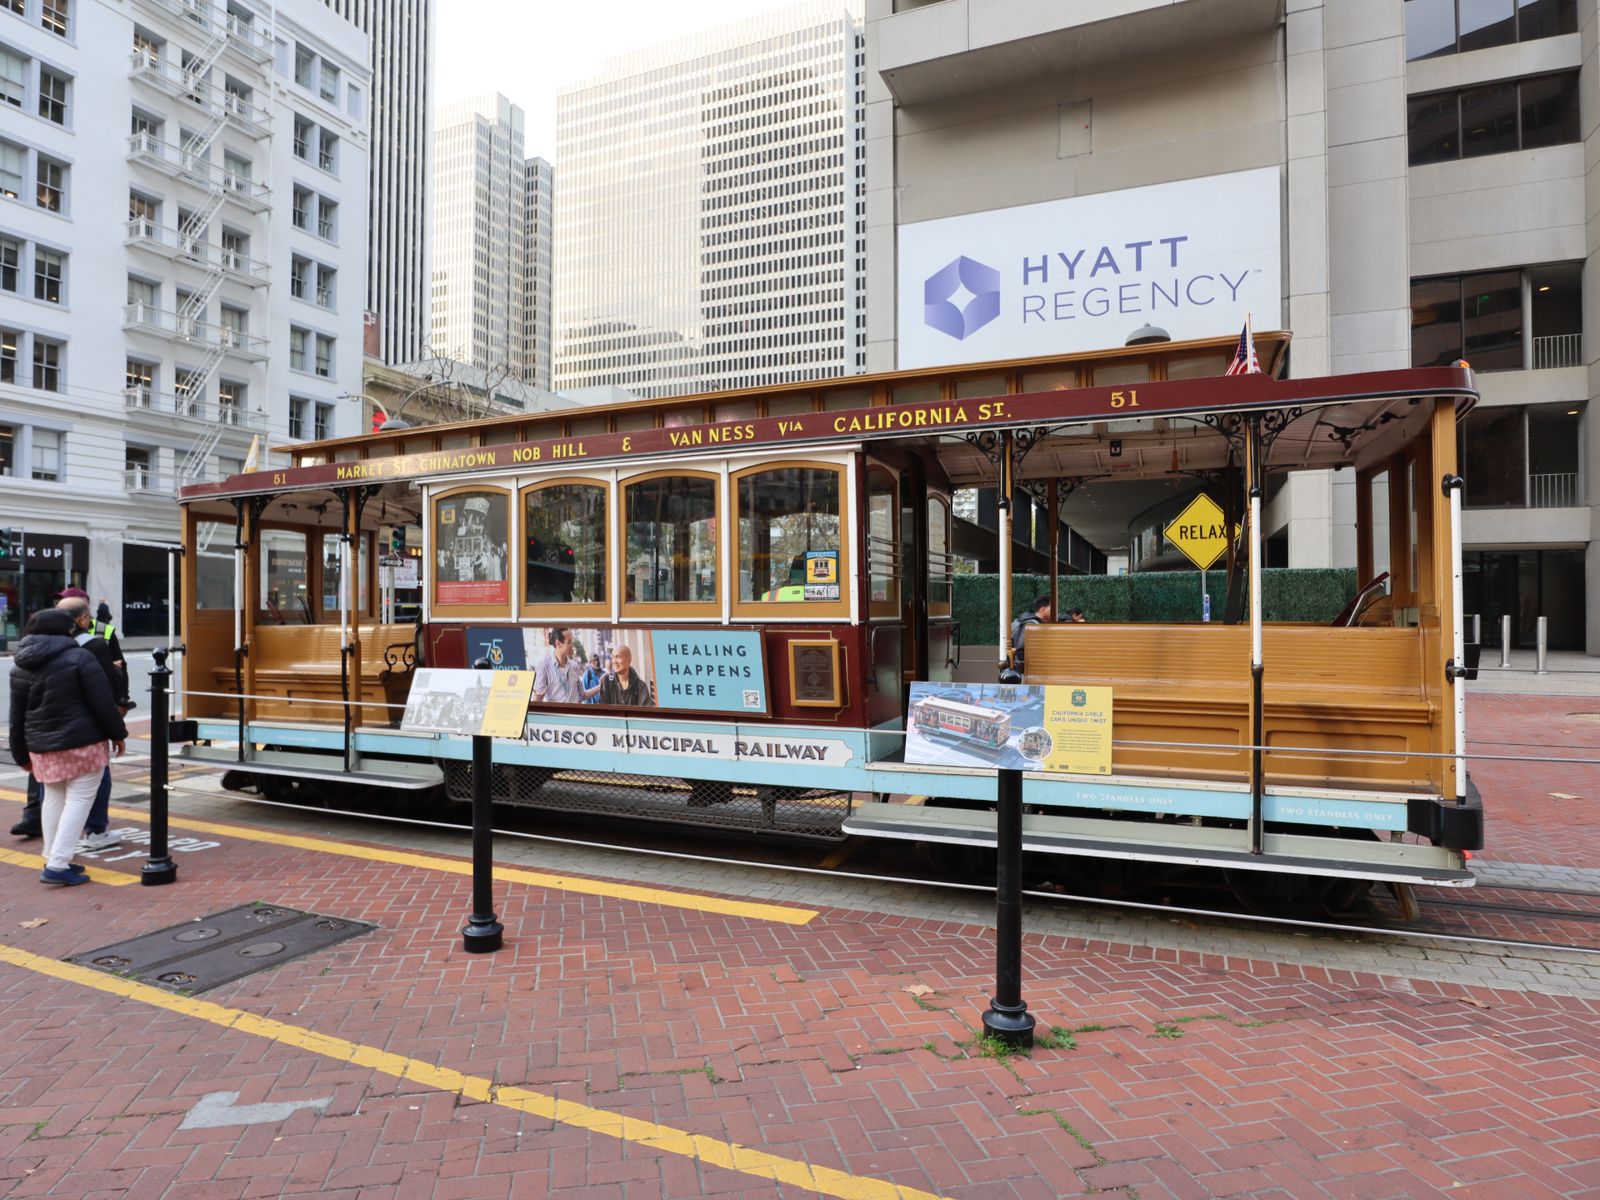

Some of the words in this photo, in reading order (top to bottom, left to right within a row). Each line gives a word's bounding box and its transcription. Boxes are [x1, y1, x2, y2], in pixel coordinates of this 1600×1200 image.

[1022, 235, 1189, 286] HYATT
[1022, 269, 1250, 324] REGENCY
[1110, 390, 1141, 408] 51
[336, 463, 384, 480] MARKET
[419, 452, 496, 472] CHINATOWN
[512, 448, 541, 463] NOB
[552, 442, 588, 459] HILL
[669, 430, 703, 448] VAN
[708, 425, 755, 443] NESS
[833, 406, 969, 433] CALIFORNIA
[273, 472, 287, 486] 51
[1179, 524, 1228, 540] RELAX
[9, 545, 37, 557] ICK
[42, 547, 63, 559] UP
[479, 638, 505, 665] 75
[667, 643, 748, 658] HEALING
[669, 663, 752, 679] HAPPENS
[671, 683, 717, 697] HERE
[495, 728, 599, 746] NCISCO
[612, 733, 720, 754] MUNICIPAL
[734, 741, 829, 761] RAILWAY
[1076, 792, 1097, 800] TWO
[1099, 792, 1145, 804] STANDEES
[1148, 797, 1174, 805] ONLY
[1280, 807, 1304, 816] TWO
[1307, 808, 1361, 820] STANDEES
[1364, 812, 1393, 821] ONLY
